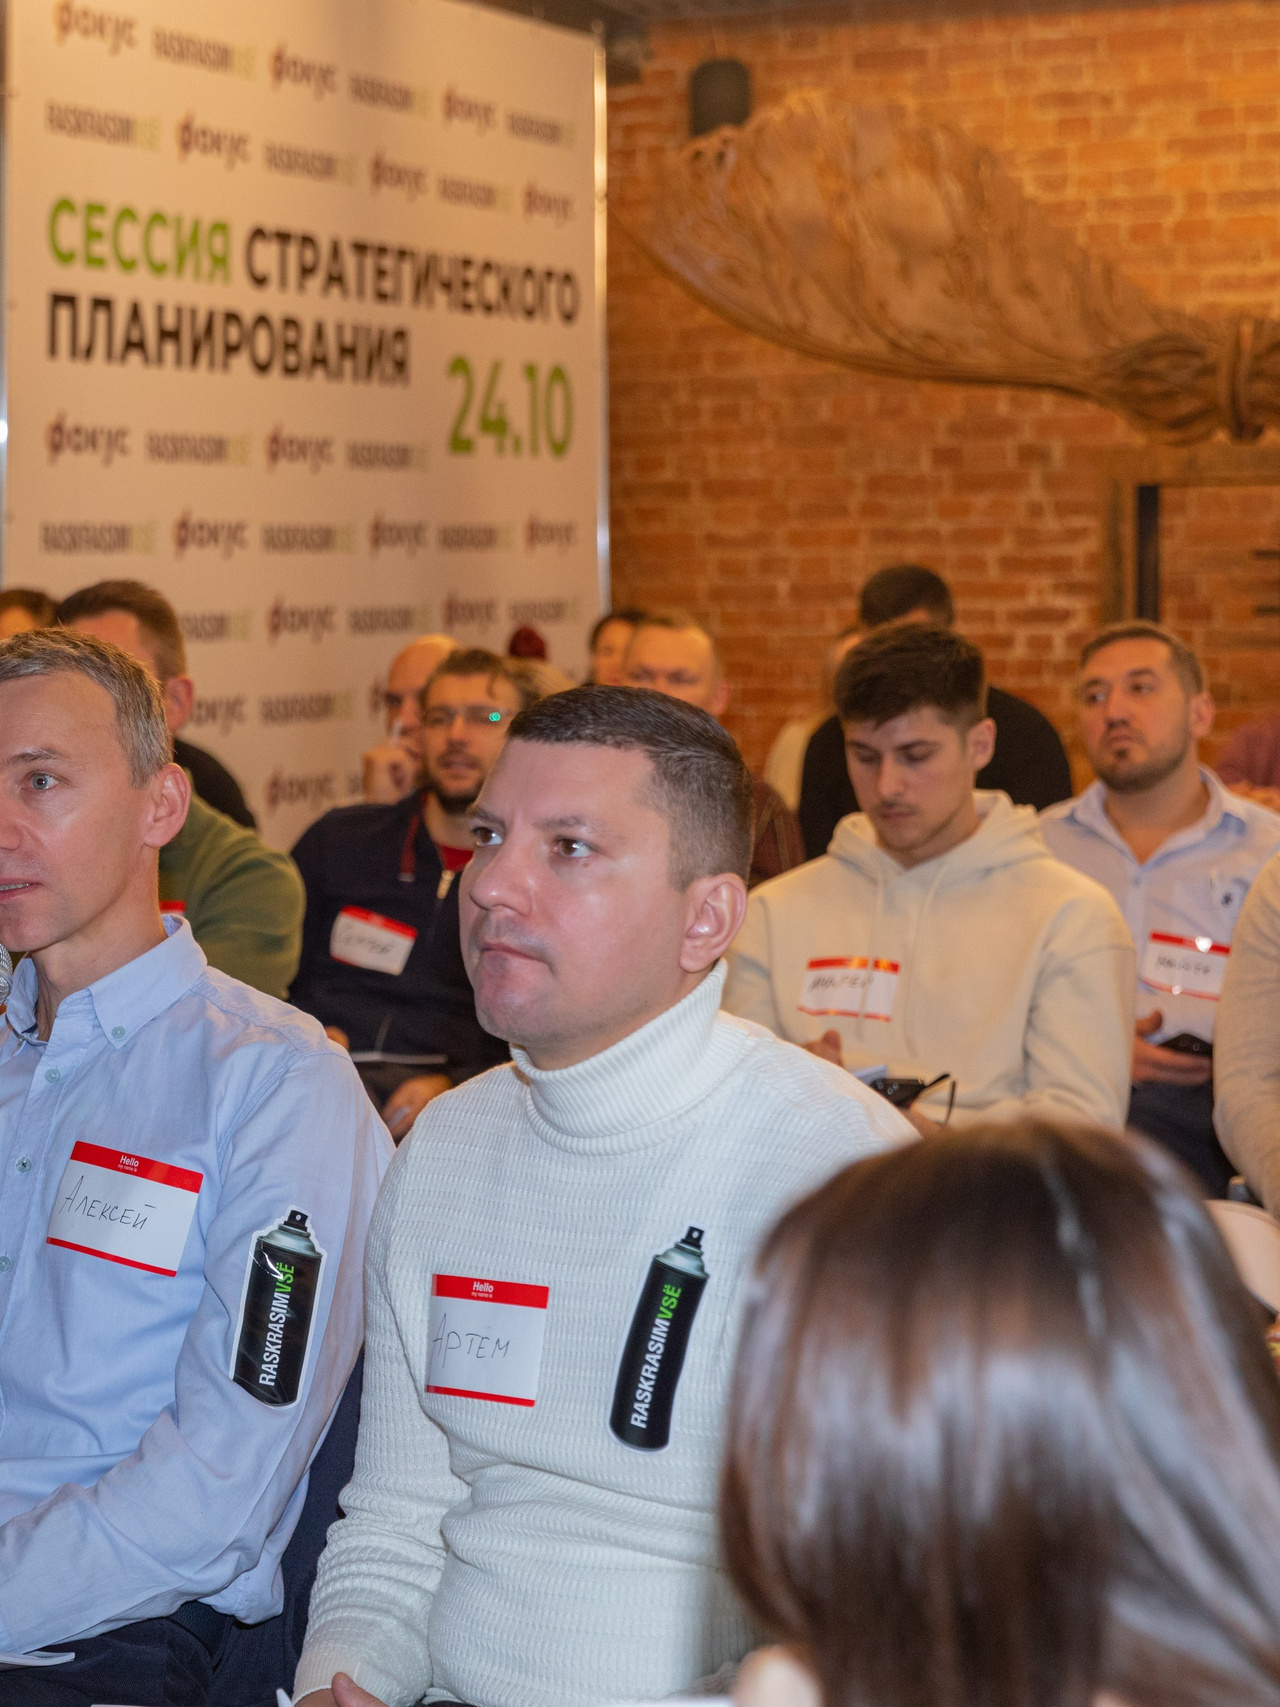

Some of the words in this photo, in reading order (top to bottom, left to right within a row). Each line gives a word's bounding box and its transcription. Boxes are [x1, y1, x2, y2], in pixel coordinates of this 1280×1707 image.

[48, 198, 231, 284] СЕССИЯ
[245, 226, 580, 327] СТРАТЕГИЧЕСКОГО
[47, 294, 410, 387] ПЛАНИРОВАНИЯ
[447, 355, 575, 458] 24.10
[120, 1155, 139, 1168] Hello
[472, 1281, 494, 1293] Hello
